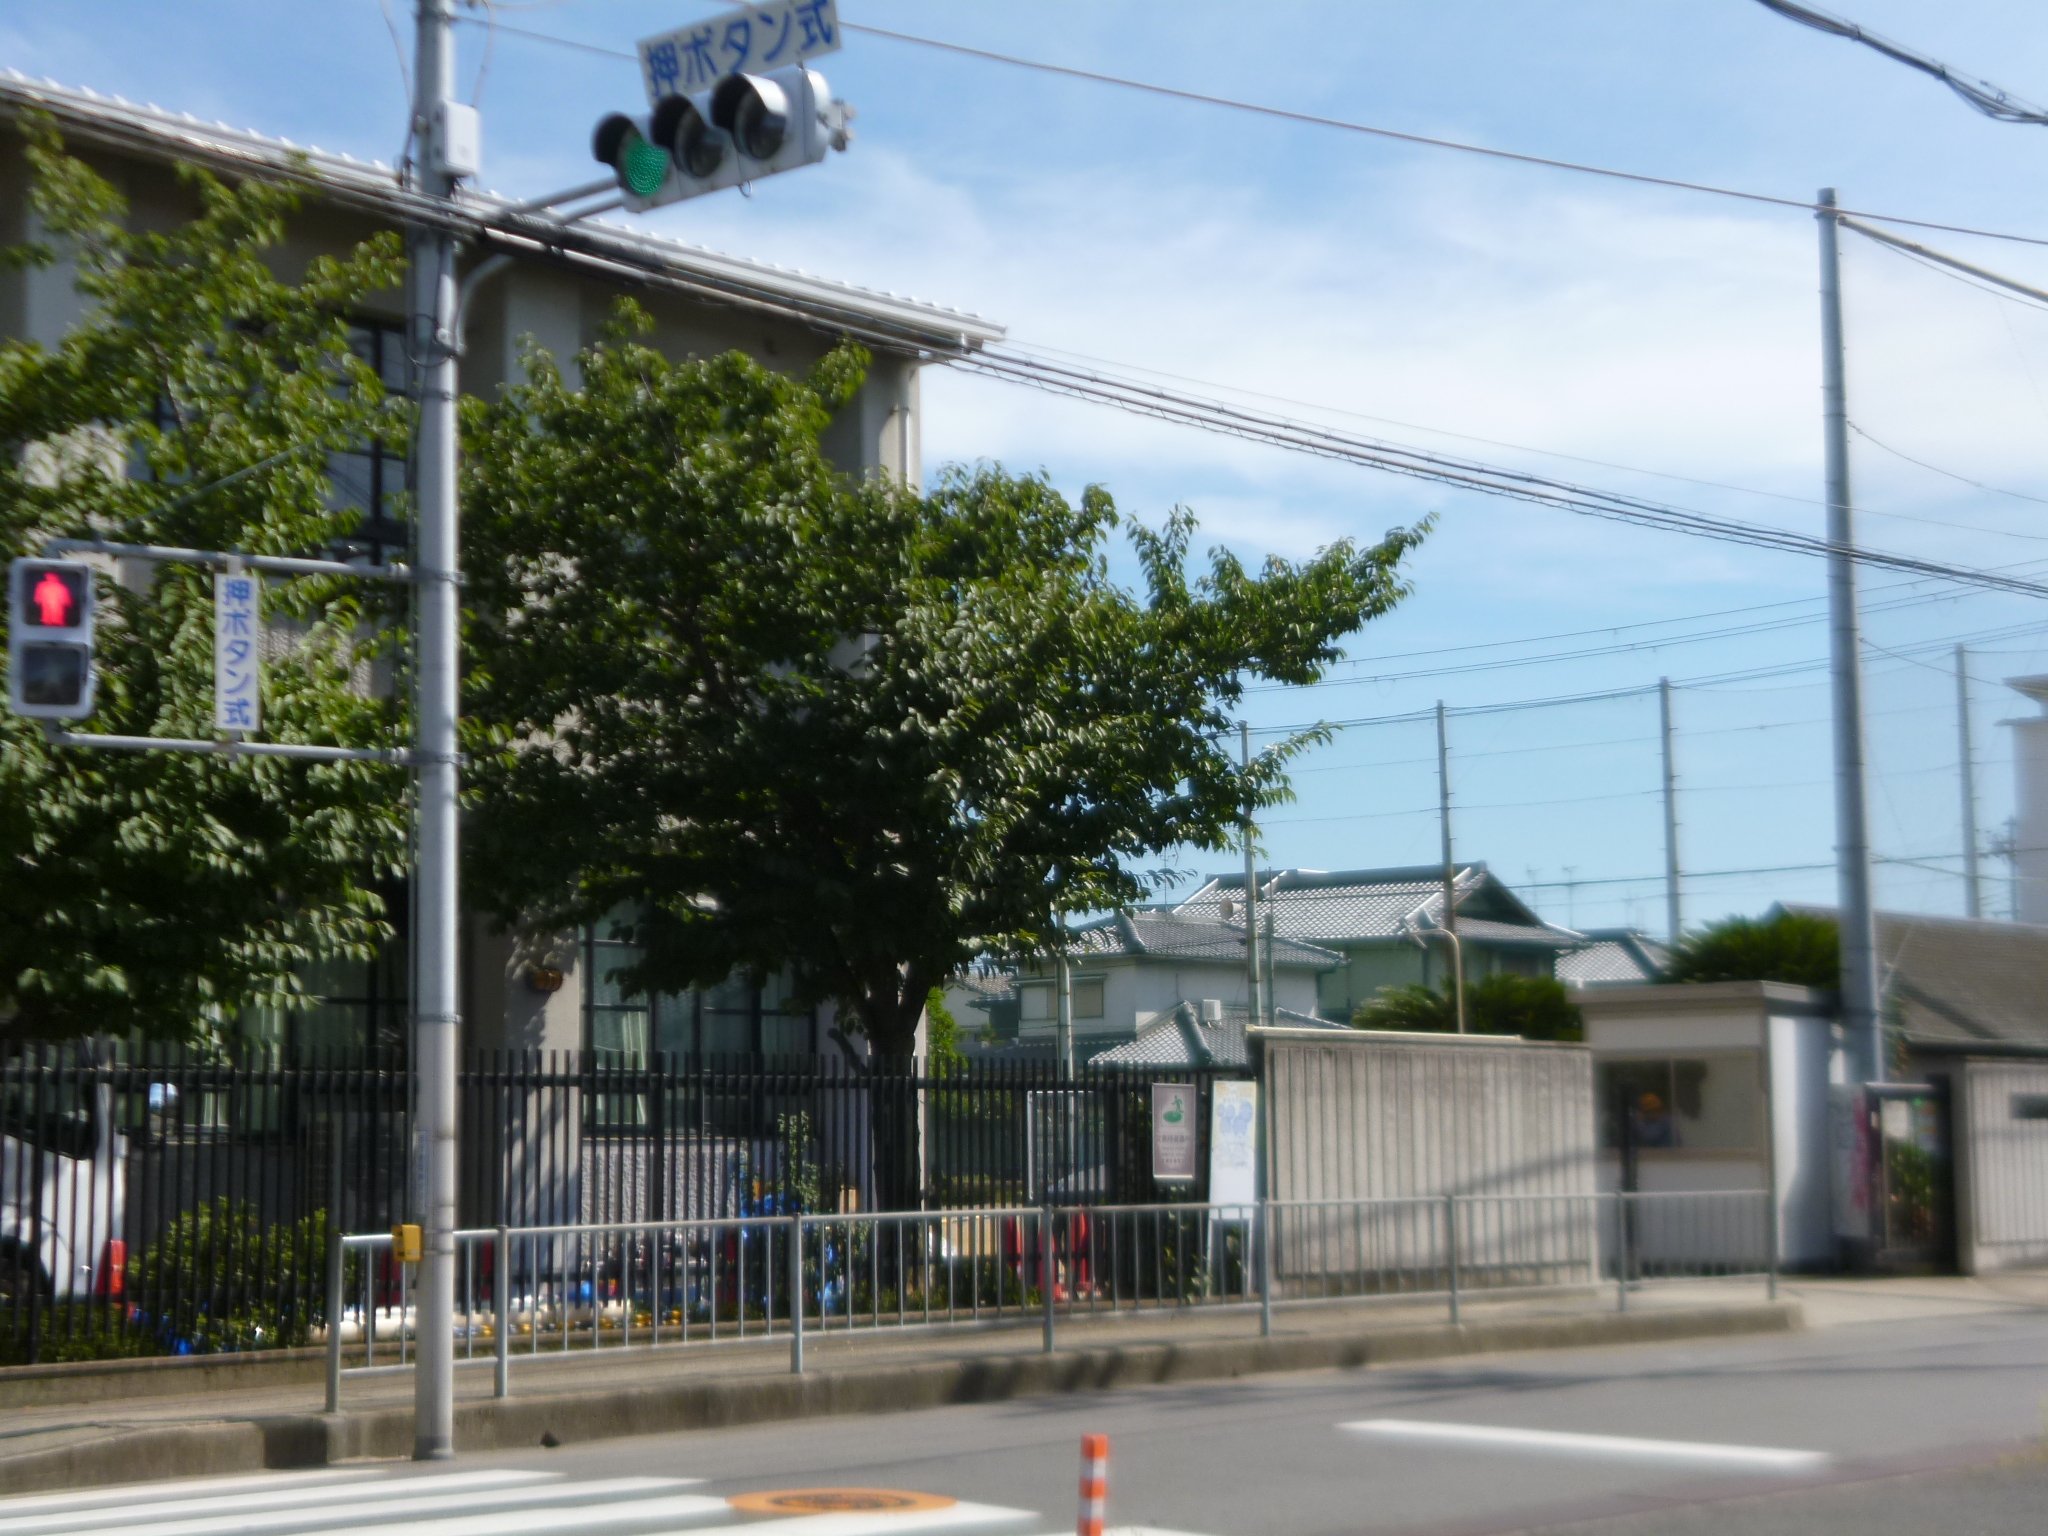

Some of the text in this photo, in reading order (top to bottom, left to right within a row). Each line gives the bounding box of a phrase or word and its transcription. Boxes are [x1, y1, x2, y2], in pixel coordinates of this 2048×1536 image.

[646, 0, 833, 97] 押ボタン式
[222, 578, 252, 727] 押ボタン式
